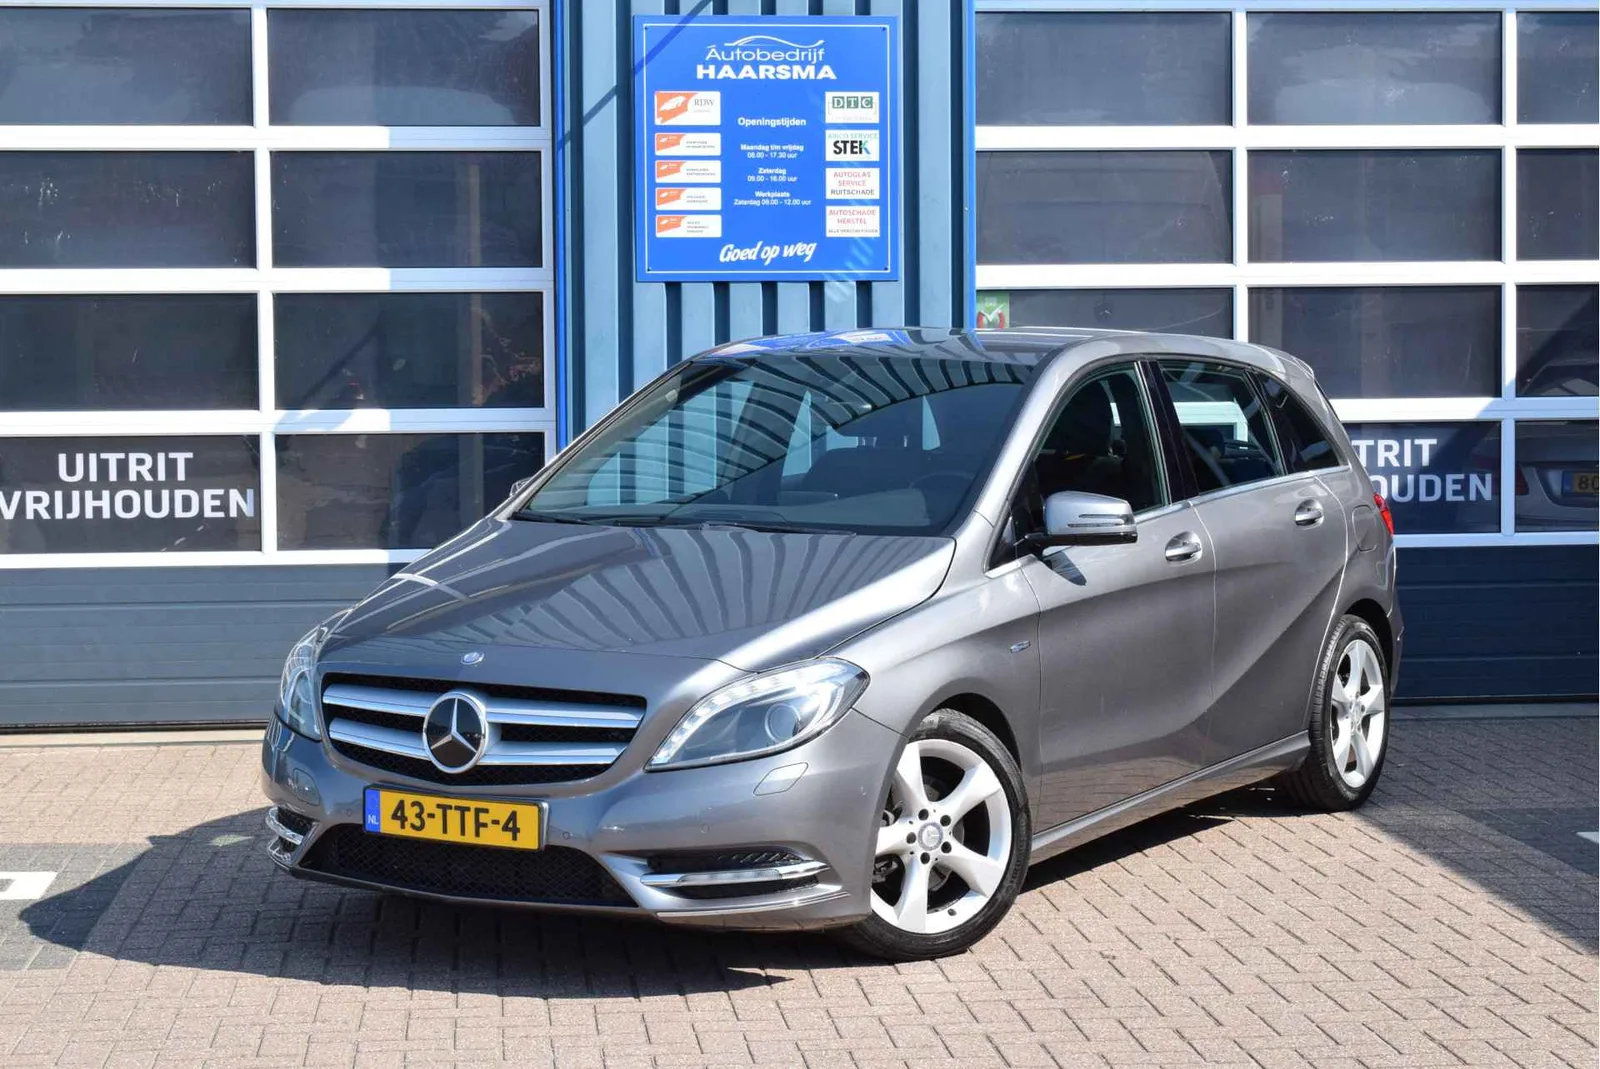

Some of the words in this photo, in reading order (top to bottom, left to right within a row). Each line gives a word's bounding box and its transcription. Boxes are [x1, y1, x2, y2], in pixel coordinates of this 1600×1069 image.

[705, 46, 825, 64] Autobedrijf
[696, 64, 837, 80] HAARSMA
[694, 99, 715, 107] RDW
[832, 96, 873, 108] DTC
[738, 117, 806, 127] Openingstijden
[740, 144, 769, 152] Maandag
[782, 144, 804, 152] vrijdag
[833, 140, 871, 155] STEK
[758, 167, 787, 175] Zaterdag
[755, 190, 791, 198] Werkplaats
[734, 199, 761, 207] Zaterdag
[719, 240, 763, 262] Goed
[761, 245, 780, 266] op
[782, 241, 817, 262] weg
[1352, 438, 1437, 468] TRIT
[58, 452, 194, 482] UITRIT
[1370, 473, 1492, 502] OUDEN
[0, 488, 254, 519] VRIJHOUDEN
[368, 815, 379, 825] NL
[391, 799, 520, 841] 43-TTF-4
